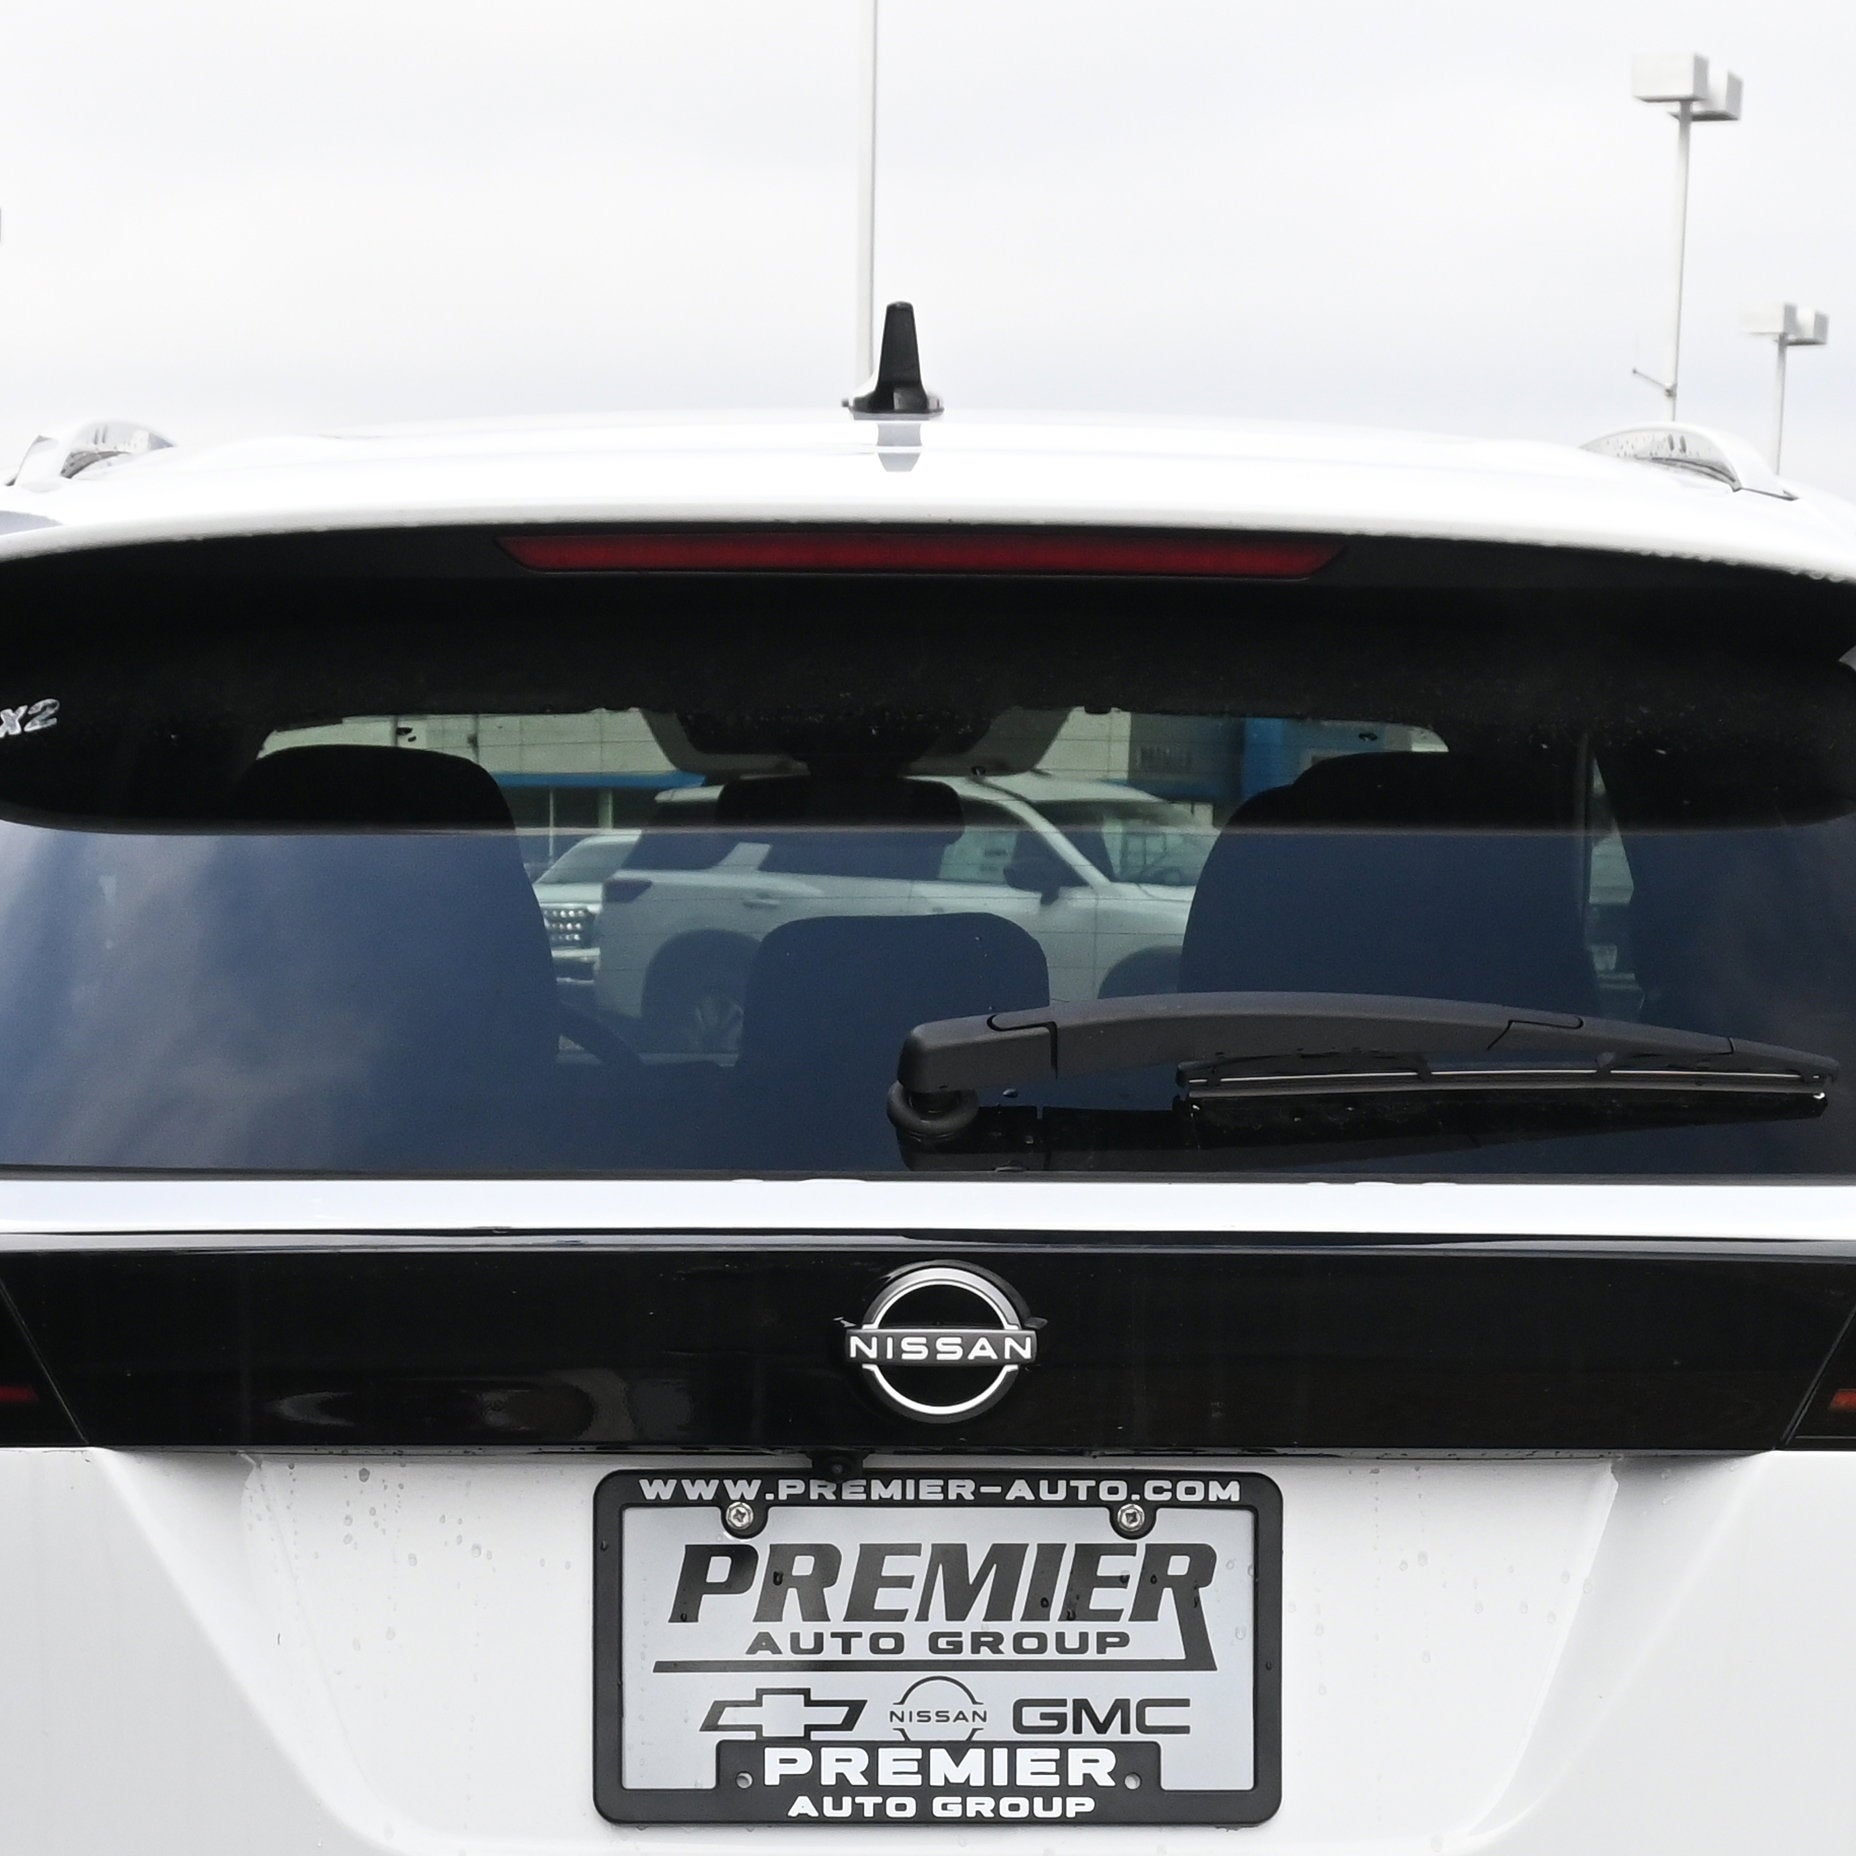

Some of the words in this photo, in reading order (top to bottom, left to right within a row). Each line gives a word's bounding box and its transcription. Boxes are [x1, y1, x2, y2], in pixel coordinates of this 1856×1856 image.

[849, 1336, 1033, 1361] NISSAN
[639, 1478, 1241, 1502] WWW.PREMIER-AUTO.COM
[667, 1542, 1218, 1624] PREMIER
[745, 1631, 906, 1655] AUTO
[927, 1631, 1131, 1656] GROUP
[889, 1708, 987, 1724] NISSAN
[1012, 1698, 1191, 1735] GMC
[763, 1747, 1117, 1787] PREMIER
[787, 1796, 916, 1818] AUTO
[932, 1796, 1095, 1818] GROUP
